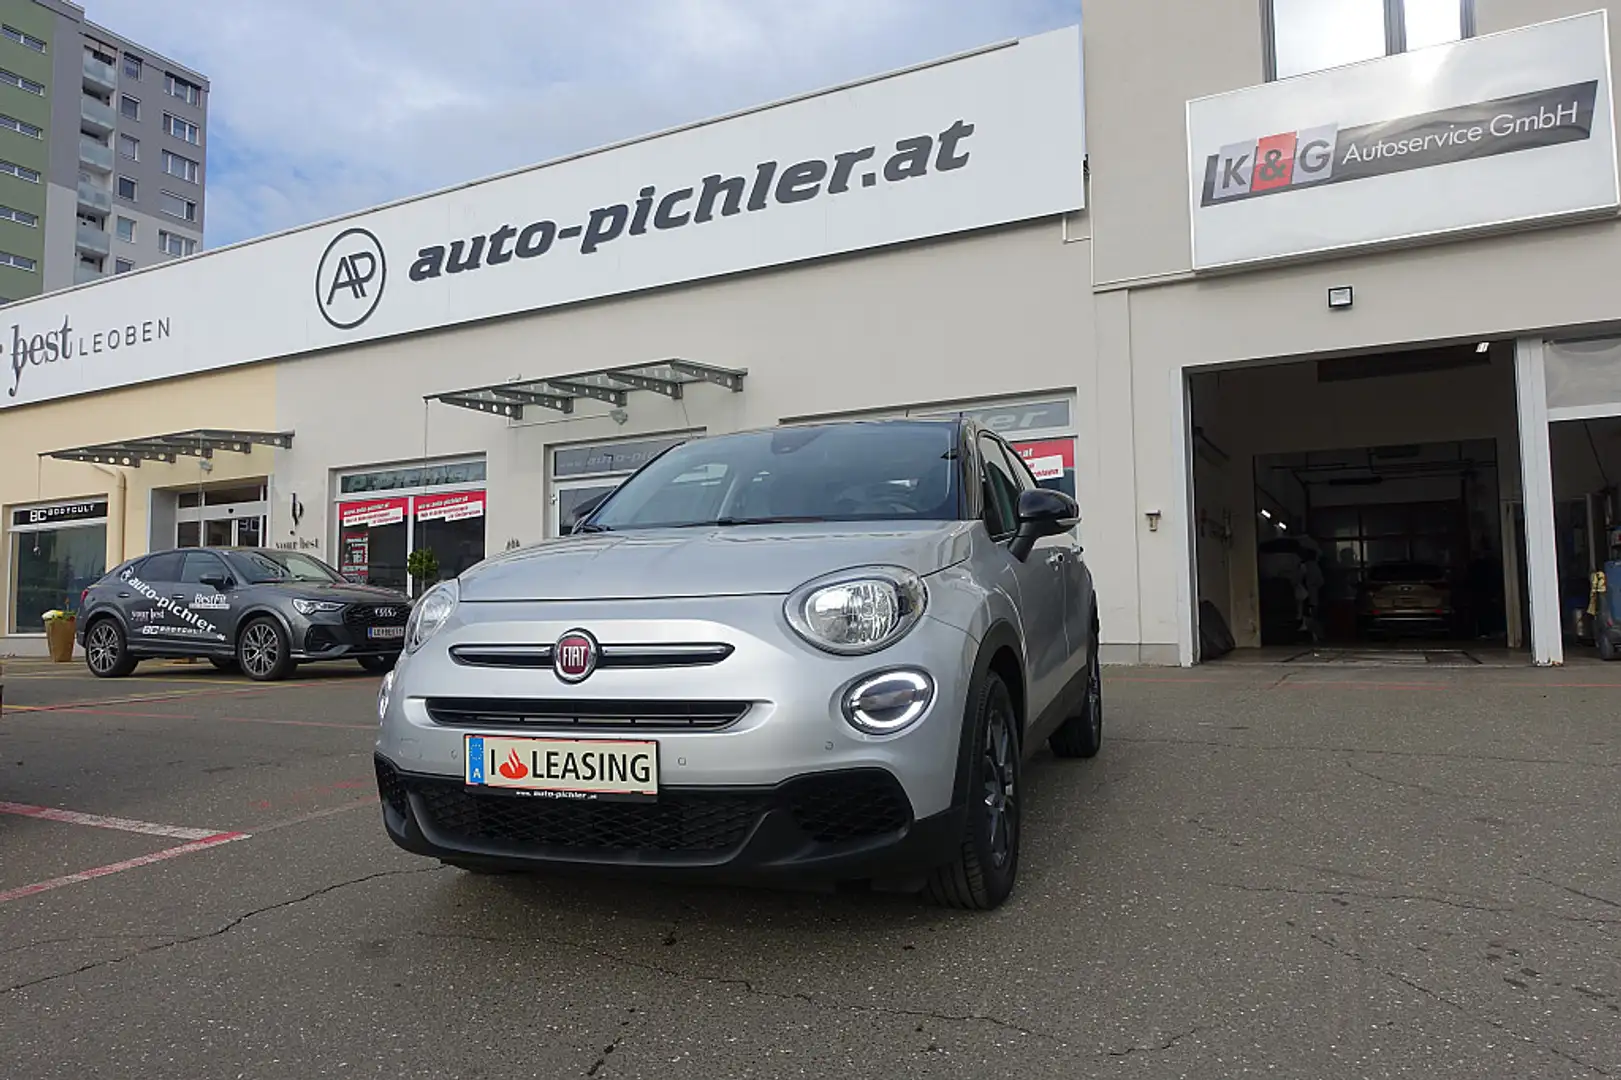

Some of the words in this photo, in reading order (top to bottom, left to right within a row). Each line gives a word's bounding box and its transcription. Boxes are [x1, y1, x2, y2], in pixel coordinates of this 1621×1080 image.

[1342, 123, 1484, 165] Autoservice
[1490, 100, 1579, 138] GmbH
[407, 119, 975, 282] auto-pichler.at
[8, 313, 74, 397] best
[79, 316, 171, 357] LEOBEN
[29, 509, 47, 522] BC
[47, 504, 95, 516] BODYCULT
[563, 645, 587, 668] FIAT
[472, 767, 482, 779] A
[490, 748, 496, 776] I
[531, 750, 651, 783] LEASING
